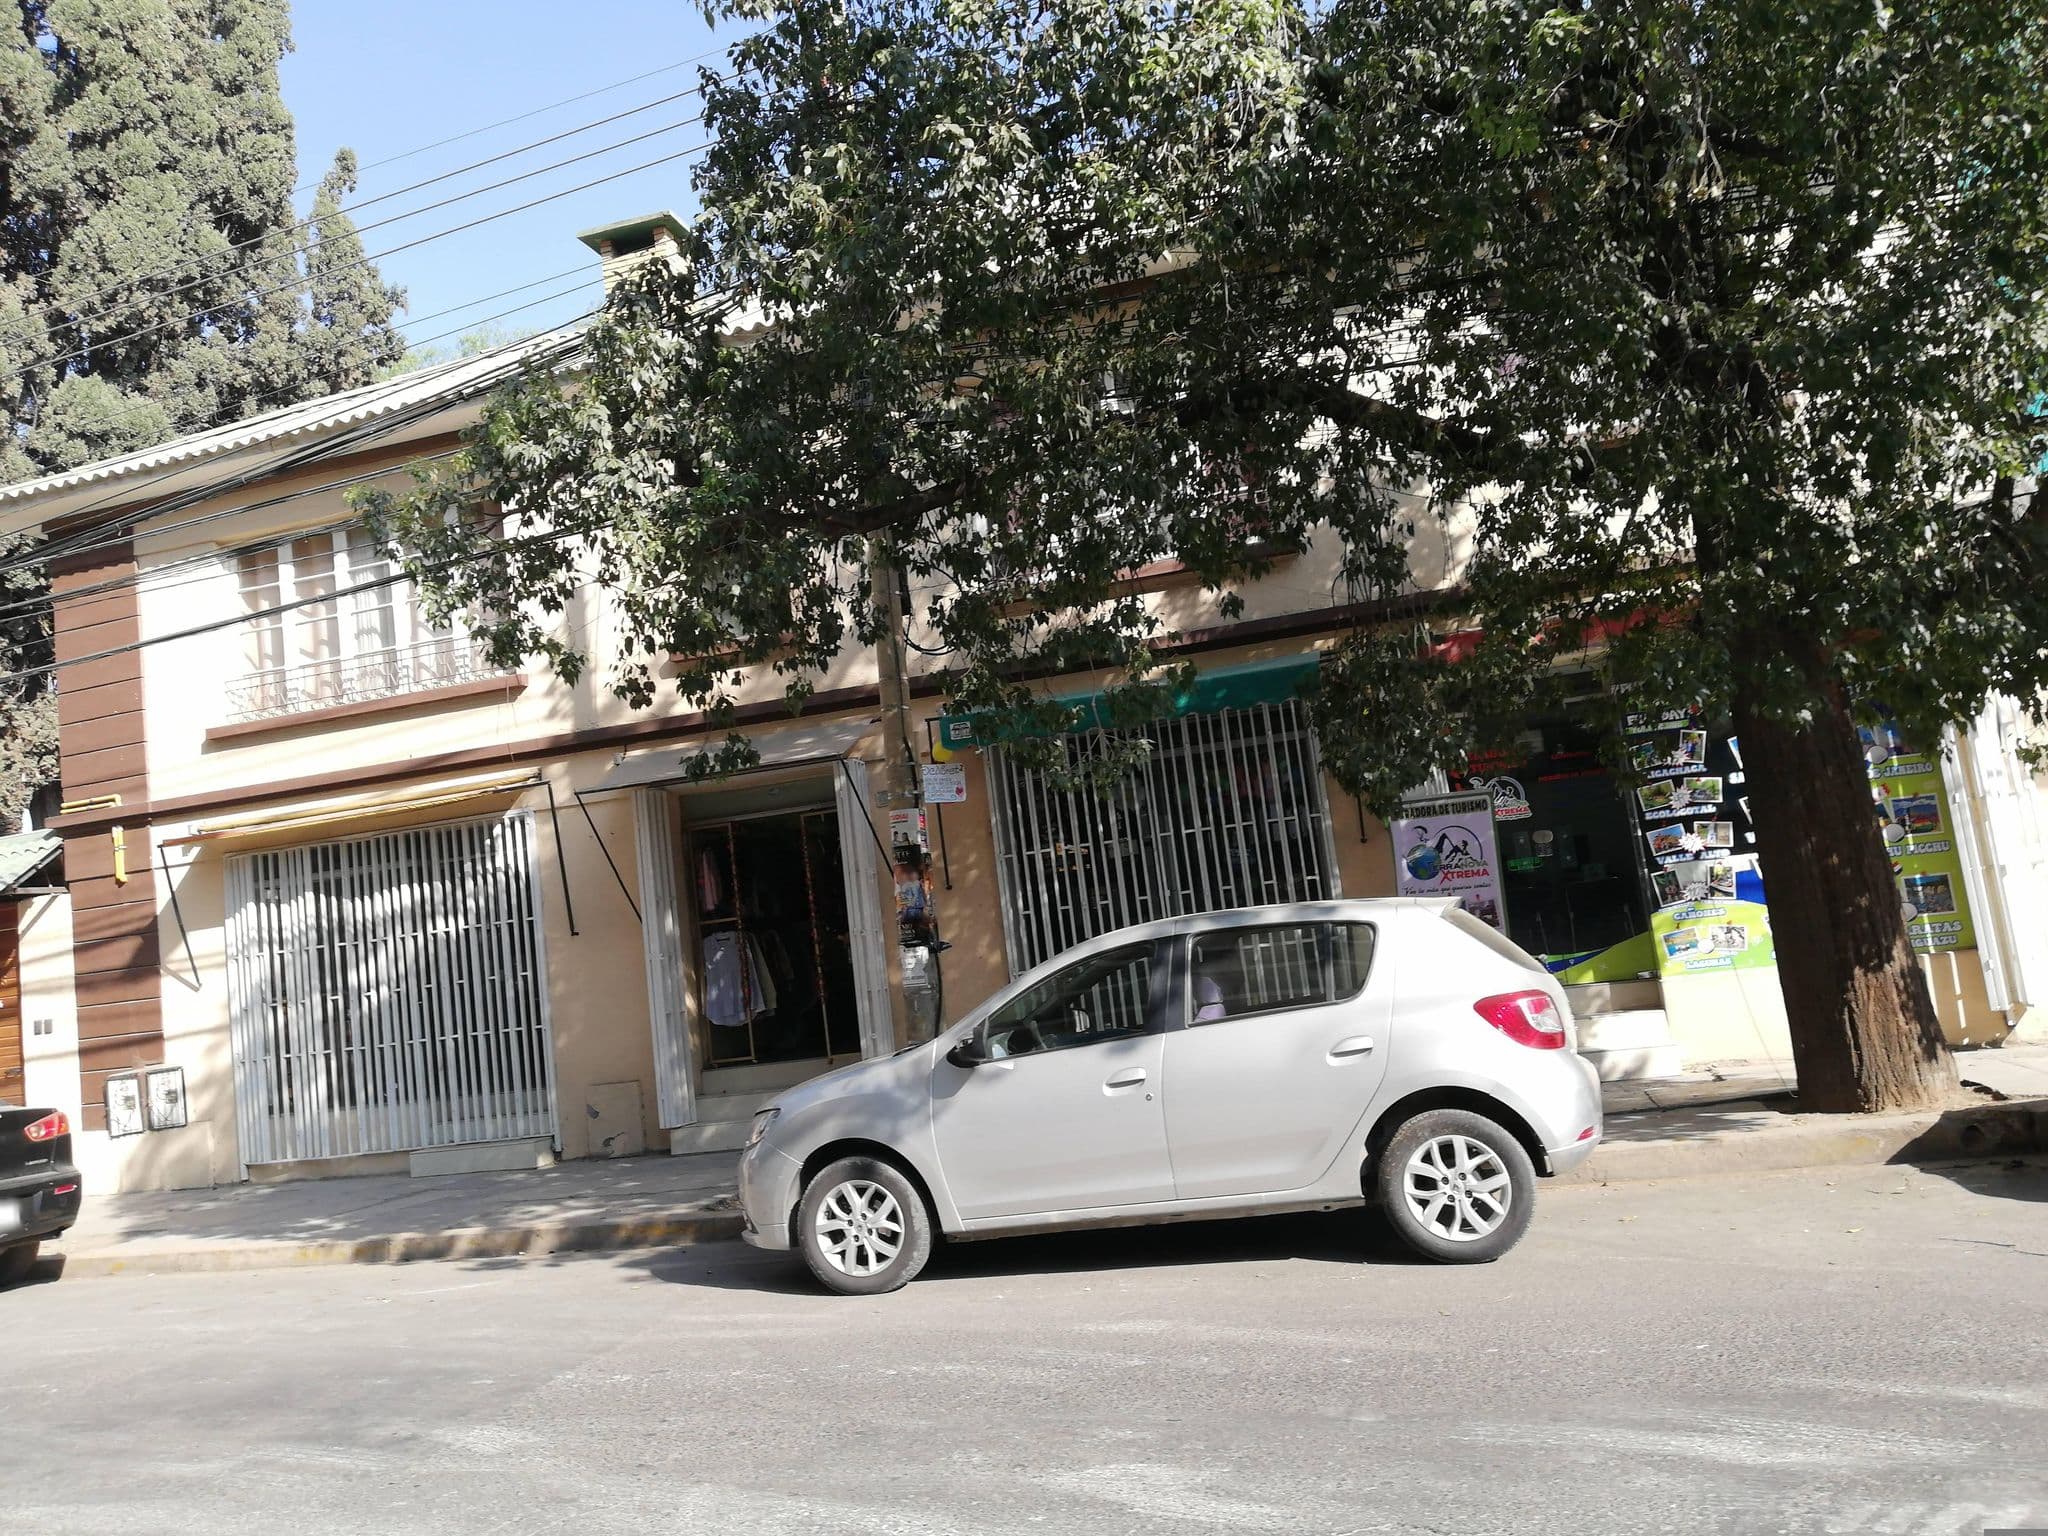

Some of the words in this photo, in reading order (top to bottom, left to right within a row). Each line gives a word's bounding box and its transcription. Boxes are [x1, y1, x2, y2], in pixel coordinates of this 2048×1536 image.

[1440, 803, 1450, 816] DE
[1451, 800, 1489, 814] TURISMO
[1655, 852, 1695, 864] VALLE
[1440, 868, 1490, 885] XTREMA
